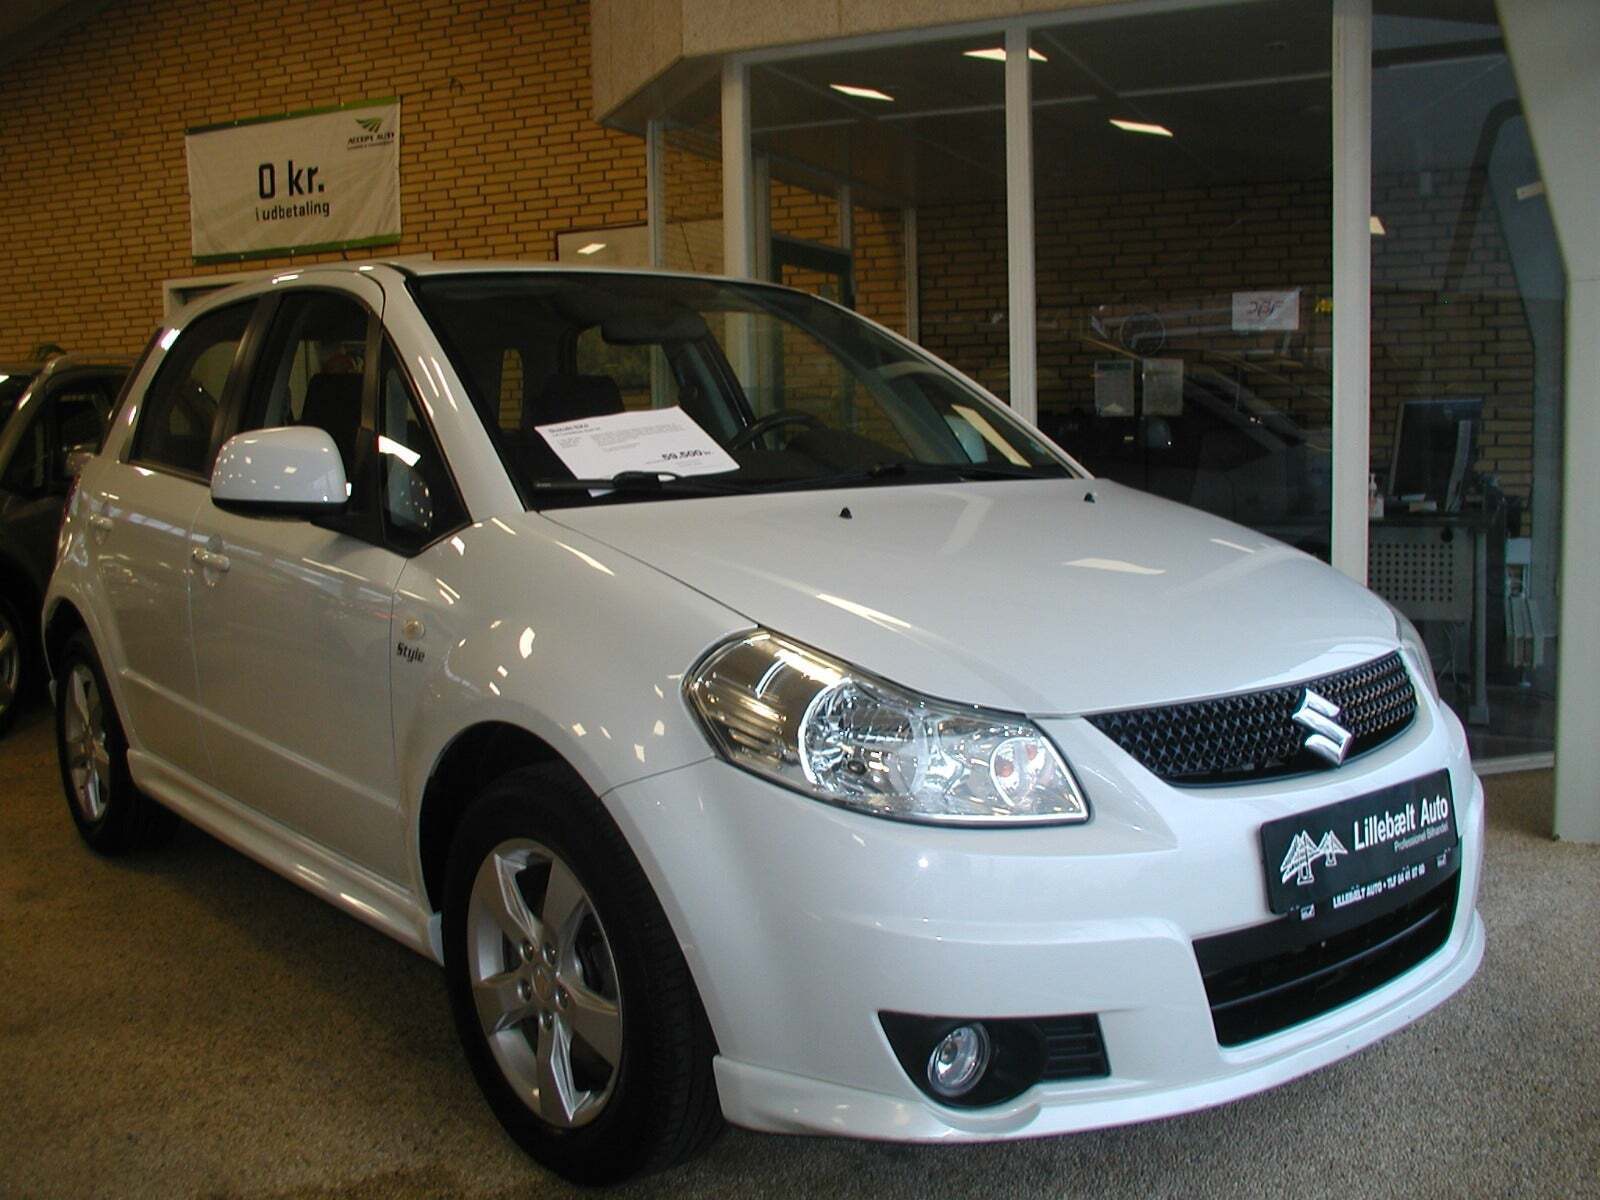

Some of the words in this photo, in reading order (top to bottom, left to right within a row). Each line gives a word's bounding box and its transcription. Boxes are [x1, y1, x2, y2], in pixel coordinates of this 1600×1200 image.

[288, 159, 325, 197] kr.
[262, 200, 330, 220] udbetaling
[396, 641, 425, 663] Style
[1353, 802, 1416, 851] Lillebælt
[1420, 793, 1449, 828] Auto
